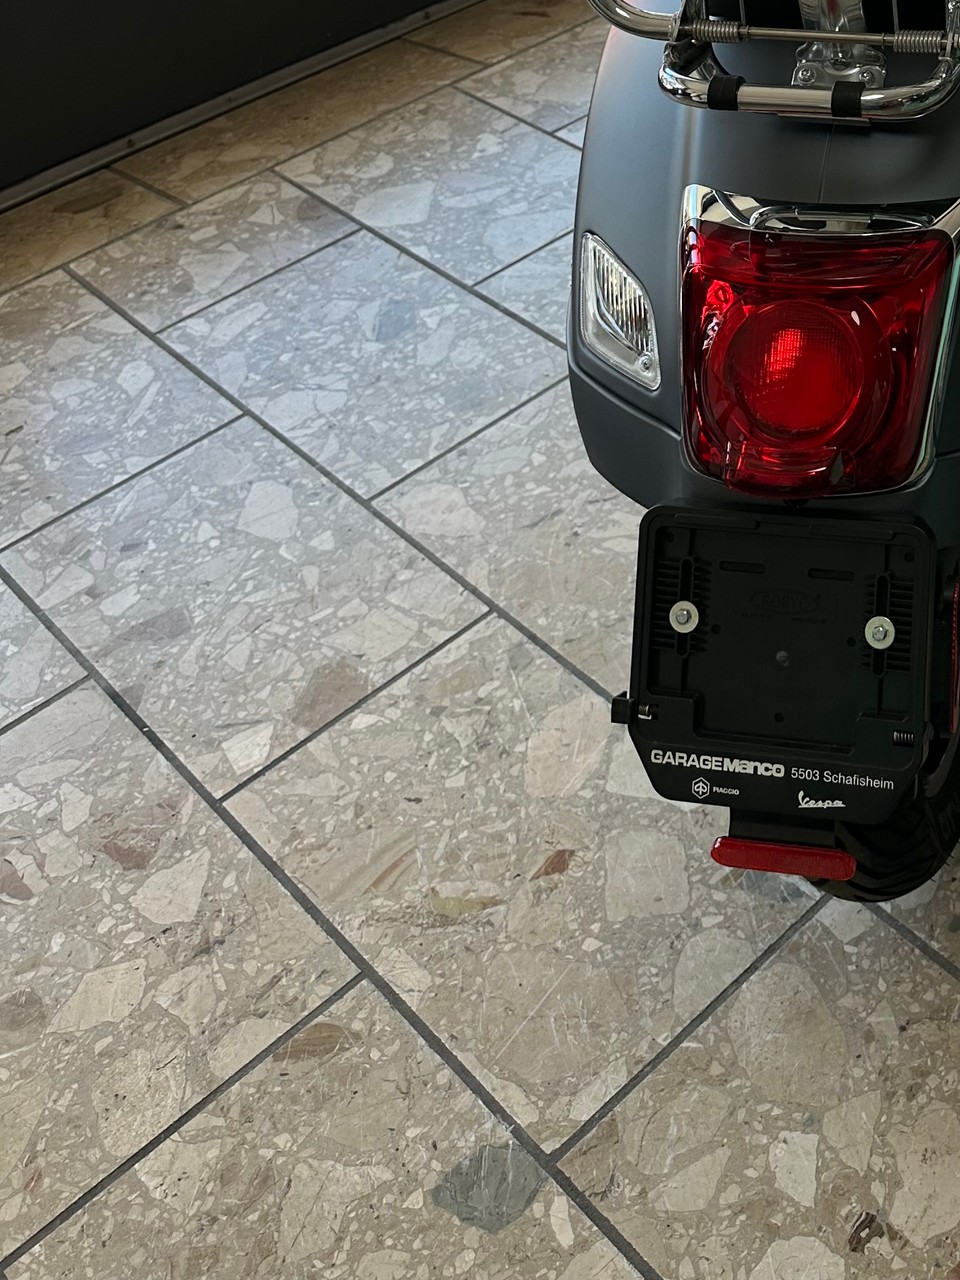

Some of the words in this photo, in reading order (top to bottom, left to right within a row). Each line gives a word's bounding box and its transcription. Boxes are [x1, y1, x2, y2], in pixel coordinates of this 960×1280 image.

[791, 767, 820, 781] 5503
[823, 770, 894, 790] Schafisheim
[712, 786, 740, 795] PIAGGIO
[798, 790, 846, 809] Vespa
